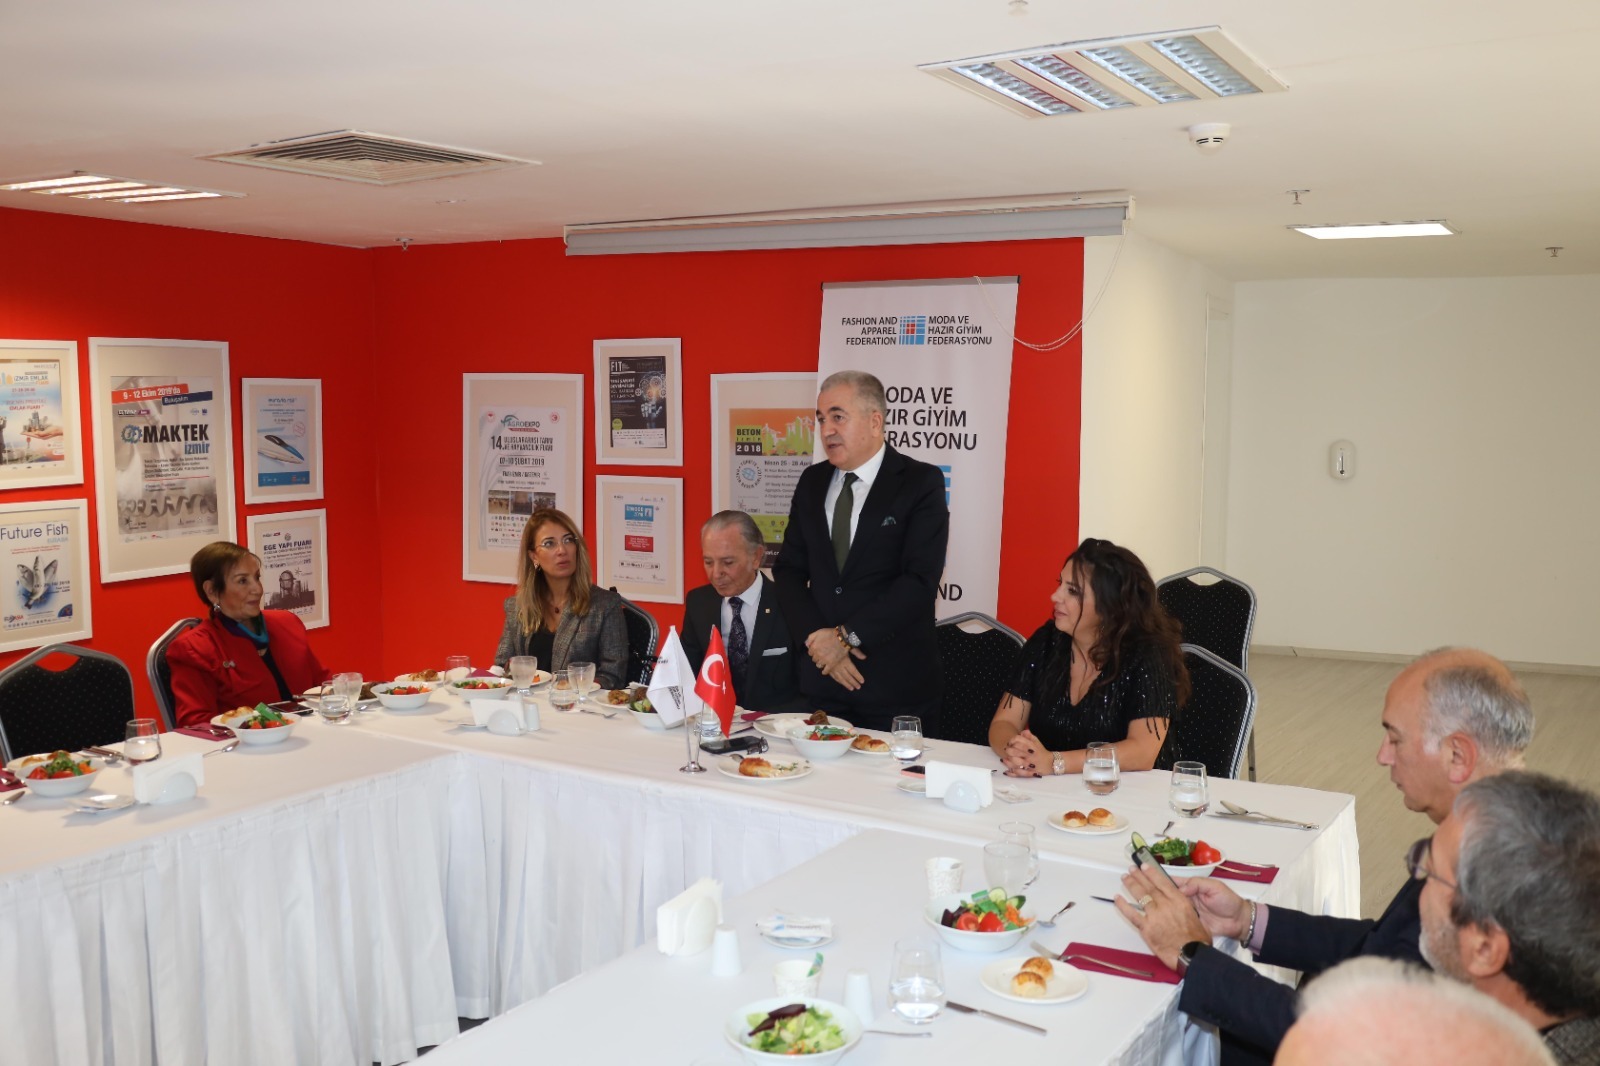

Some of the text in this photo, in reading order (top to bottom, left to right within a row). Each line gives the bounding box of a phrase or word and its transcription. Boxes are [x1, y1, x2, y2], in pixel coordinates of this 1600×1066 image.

[841, 316, 898, 326] FASHION AND
[928, 315, 970, 325] MODA VE
[861, 326, 897, 335] APPAREL
[928, 324, 982, 334] HAZIR GİYİM
[846, 336, 896, 345] FEDERATION
[927, 336, 992, 345] FEDERASYONU
[610, 361, 622, 372] FIT
[123, 392, 128, 400] 9
[133, 391, 141, 399] 12
[142, 389, 156, 397] Ekim
[885, 386, 953, 404] ODA VE
[885, 406, 966, 427] ZIR GİYİM
[507, 420, 541, 428] AGROEXPO
[143, 424, 209, 443] MAKTEK
[737, 428, 761, 436] BETON
[884, 430, 977, 450] RASYONU
[184, 441, 210, 454] izmir
[736, 444, 761, 452] 2018
[0, 523, 69, 540] Future Fish
[293, 539, 312, 547] FUARI
[938, 583, 962, 601] ND
